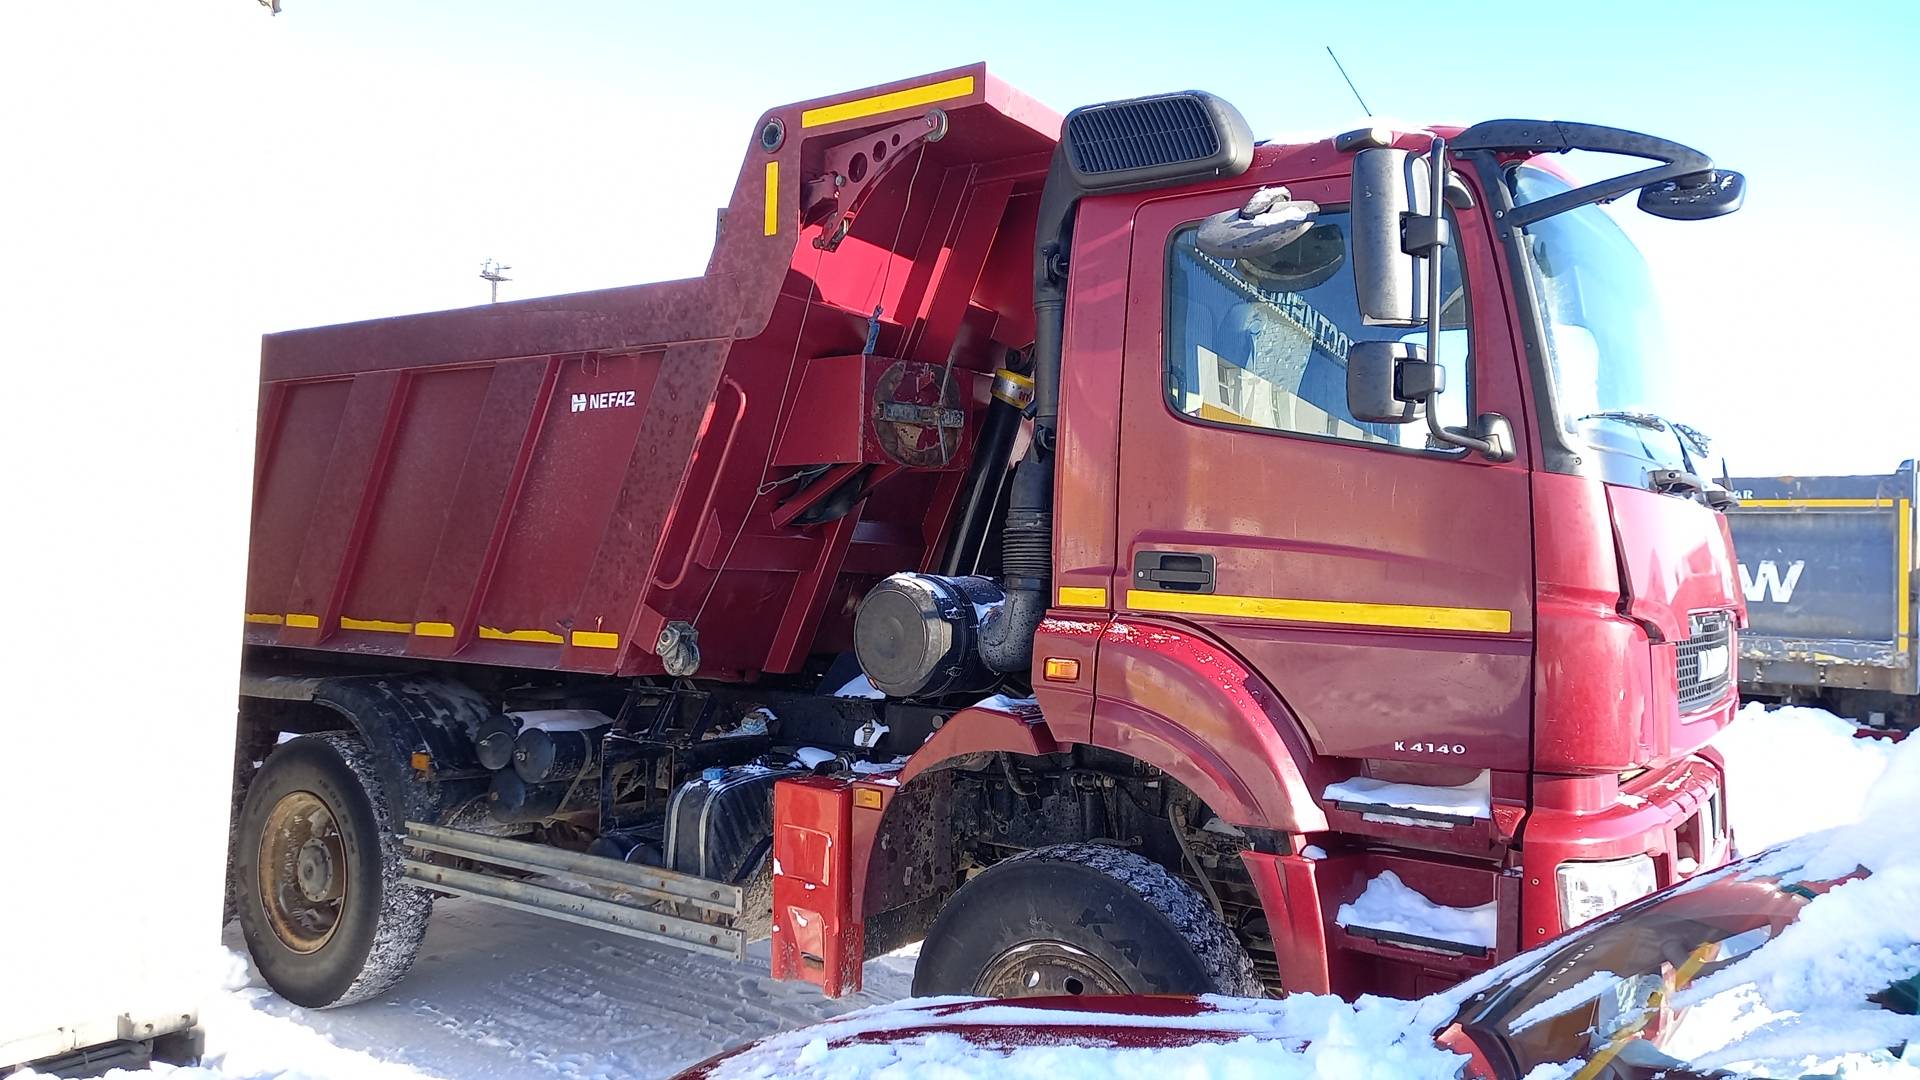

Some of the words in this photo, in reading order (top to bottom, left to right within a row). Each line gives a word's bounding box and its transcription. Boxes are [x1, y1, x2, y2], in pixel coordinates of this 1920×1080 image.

[589, 390, 636, 410] NEFAZ
[1394, 741, 1406, 752] K
[1410, 742, 1466, 755] 4140
